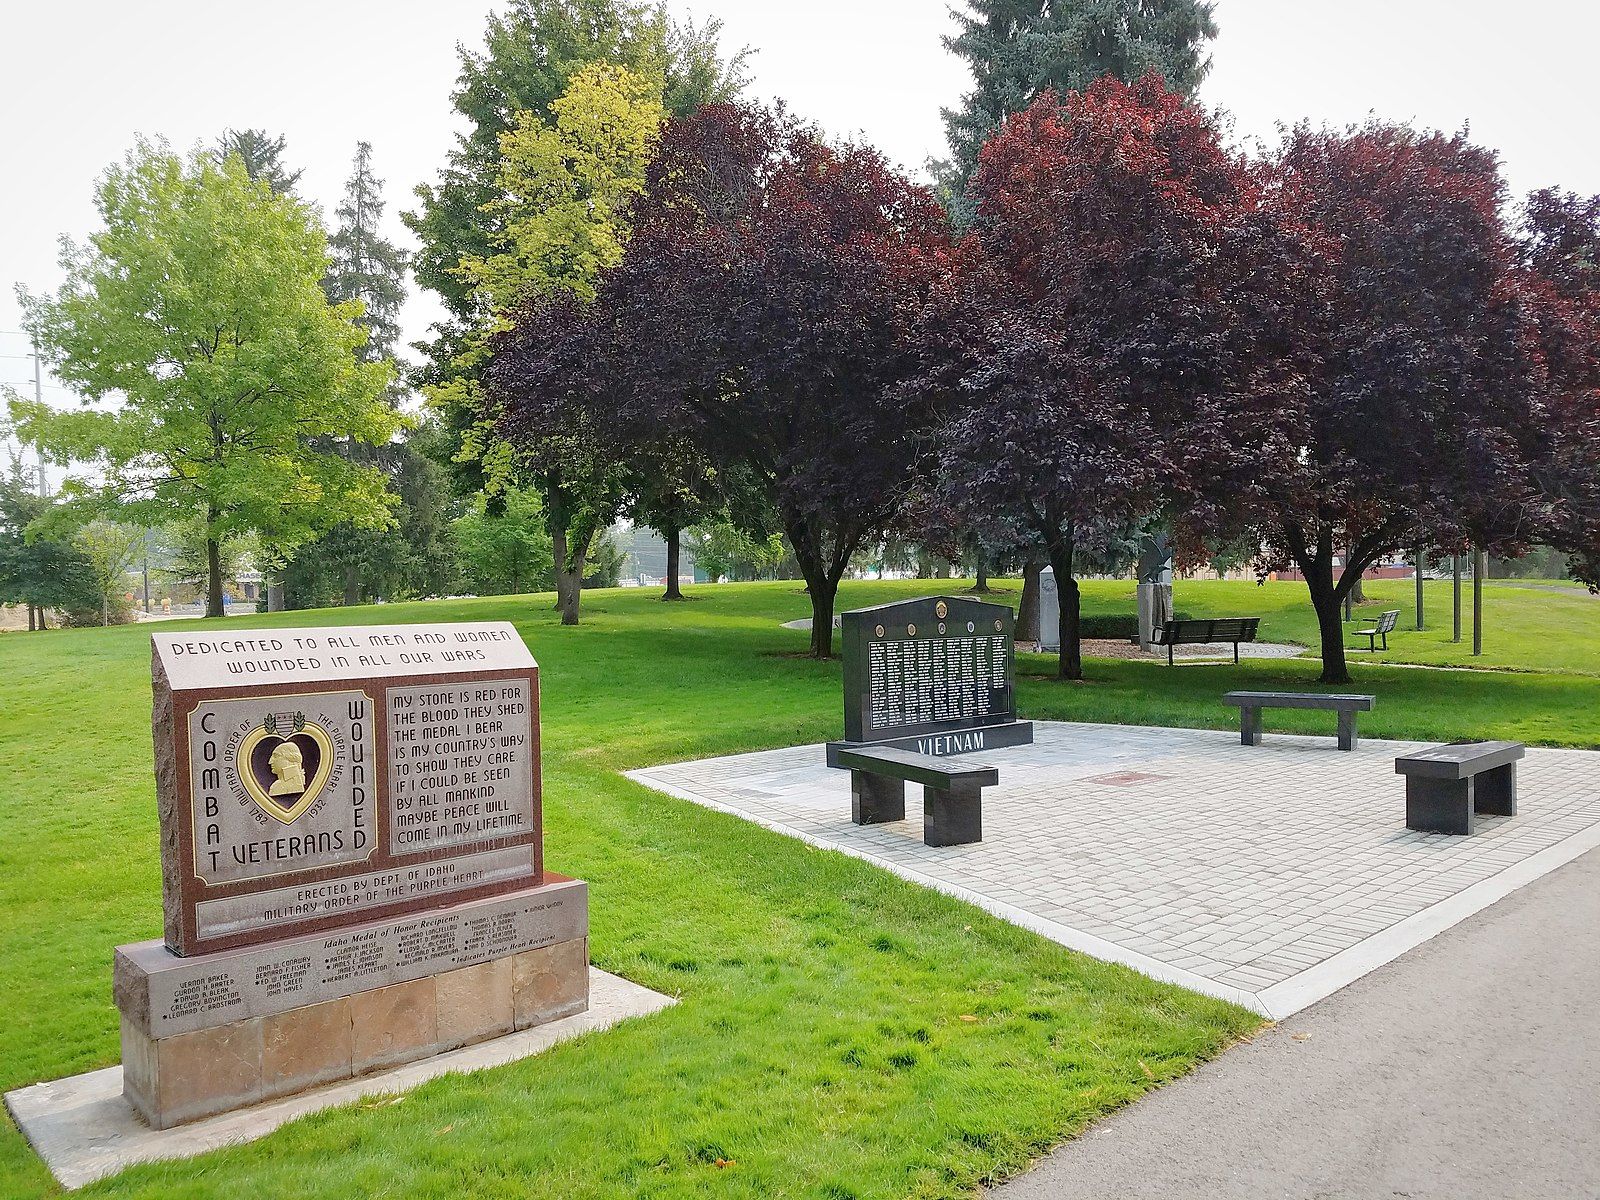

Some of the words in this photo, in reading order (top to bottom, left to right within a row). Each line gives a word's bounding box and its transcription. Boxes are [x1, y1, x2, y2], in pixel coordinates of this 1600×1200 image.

[171, 639, 283, 655] DEDICATED
[293, 638, 317, 649] TO
[327, 636, 360, 648] ALL
[369, 634, 406, 646] MEN
[413, 633, 446, 645] AND
[453, 630, 512, 643] WOMEN
[226, 657, 321, 674] WOUNDED
[330, 656, 350, 668] IN
[358, 654, 391, 667] ALL
[400, 652, 434, 664] OUR
[440, 649, 486, 662] WARS
[394, 695, 412, 709] MY
[419, 692, 454, 707] STONE
[460, 691, 470, 703] IS
[475, 689, 496, 701] RED
[501, 688, 521, 699] FOR
[240, 719, 252, 732] OF
[317, 713, 334, 729] THE
[394, 712, 416, 725] THE
[421, 708, 458, 722] BLOOD
[464, 706, 492, 719] THEY
[394, 729, 416, 742] THE
[422, 725, 461, 739] MEDAL
[466, 724, 470, 735] I
[475, 721, 503, 734] BEAR
[917, 731, 985, 756] VIETNAM
[224, 731, 242, 761] ORDER
[331, 728, 346, 761] PURPLE
[395, 747, 406, 759] IS
[411, 745, 430, 758] MY
[434, 737, 496, 755] COUNTRY'S
[501, 734, 524, 747] WAY
[349, 700, 366, 849] WOUNDED
[396, 764, 409, 776] TO
[416, 759, 448, 774] SHOW
[454, 755, 482, 768] THEY
[487, 751, 518, 764] CARE.
[224, 766, 250, 807] MILITARY
[326, 764, 344, 793] HEART
[396, 781, 406, 793] IF
[411, 780, 415, 791] I
[420, 774, 458, 789] COULD
[464, 772, 477, 784] BE
[484, 767, 510, 781] SEEN
[201, 712, 220, 872] COMBAT
[396, 797, 412, 810] BY
[420, 794, 439, 806] ALL
[445, 786, 495, 802] MANKIND
[249, 807, 268, 826] 1782
[308, 799, 327, 819] 1932
[397, 810, 438, 827] MAYBE
[444, 804, 480, 819] PEACE
[486, 800, 509, 813] WILL
[397, 828, 431, 844] COME
[437, 825, 447, 837] IN
[453, 821, 470, 834] MY
[476, 813, 526, 831] LIFETIME.
[233, 830, 343, 864] VETERANS
[297, 884, 347, 901] ERECTED
[354, 880, 368, 891] BY
[408, 870, 420, 880] OF
[425, 863, 455, 877] IDAHO
[264, 902, 317, 920] MILITARY
[324, 894, 359, 909] ORDER
[366, 889, 378, 901] OF
[385, 885, 404, 897] THE
[410, 877, 448, 893] PURPLE
[453, 870, 483, 884] HEART
[324, 938, 348, 949] Idaho
[351, 931, 377, 943] Medal
[380, 929, 389, 938] of
[393, 924, 418, 934] Honor
[420, 915, 460, 929] Recipients
[256, 964, 271, 973] JOHN
[280, 970, 307, 980] FREEMAN
[292, 963, 311, 971] FISHER
[180, 978, 205, 989] VERNON
[208, 973, 229, 983] BAKER
[210, 979, 235, 989] BARTER
[284, 978, 302, 987] GREEN
[284, 984, 303, 993] HAYES
[168, 1008, 198, 1019] LEONARD
[208, 997, 242, 1010] BROSTROM
[170, 1001, 201, 1012] GREGORY
[180, 993, 199, 1003] DAVID
